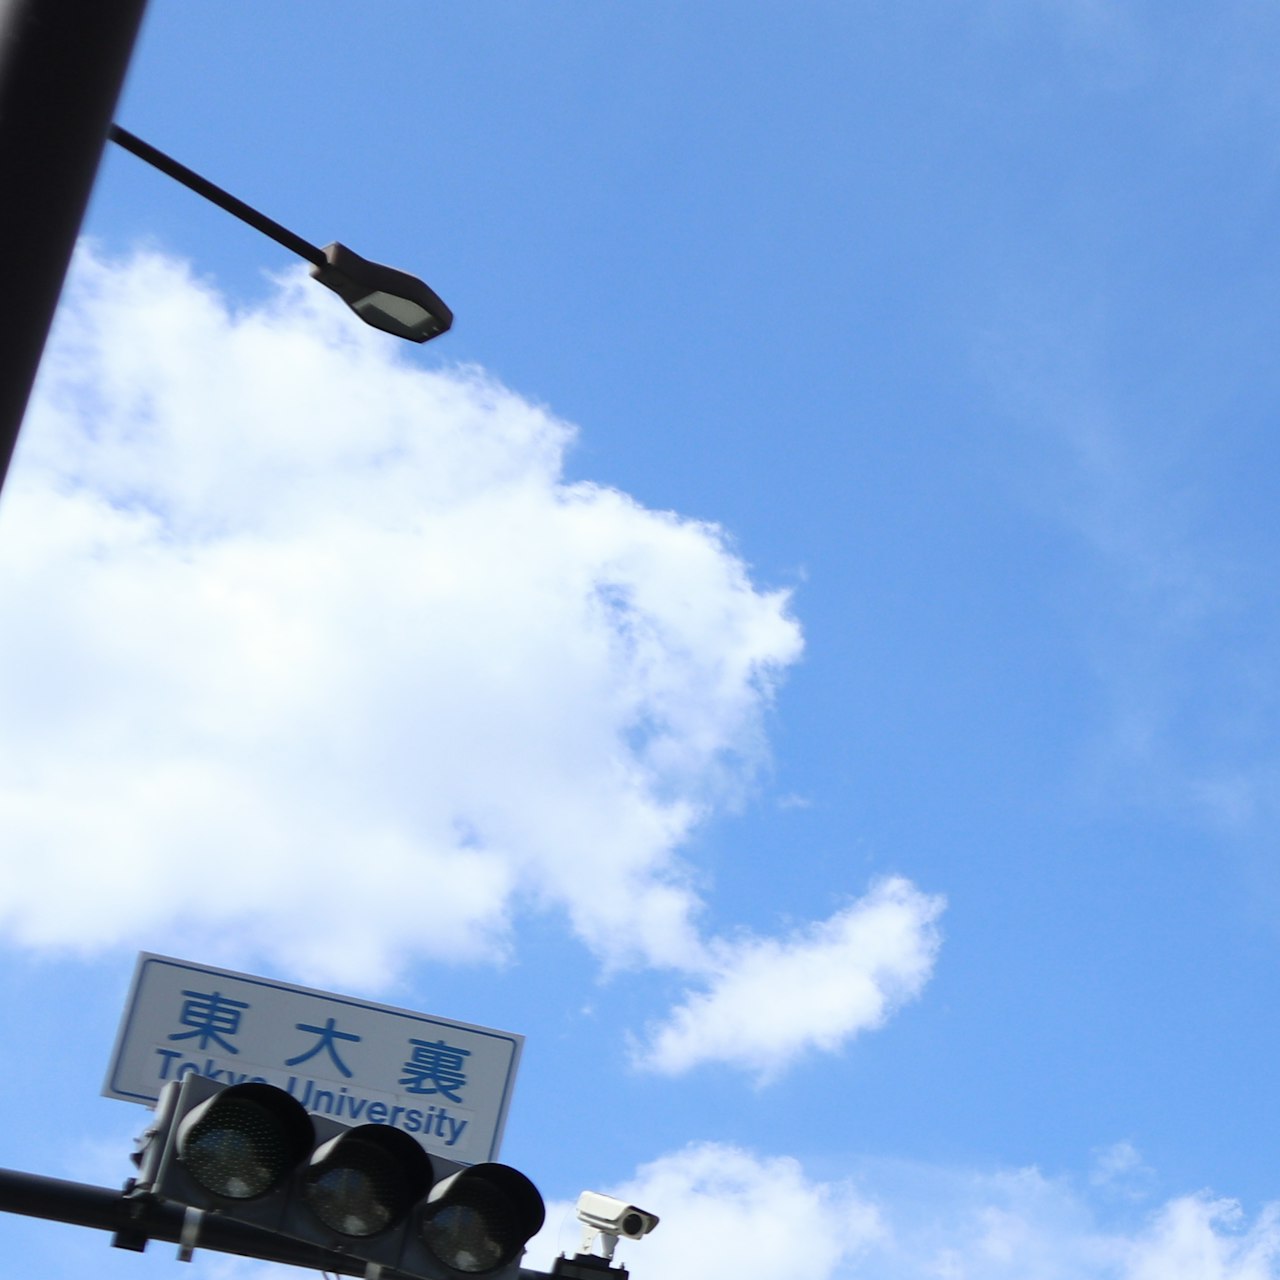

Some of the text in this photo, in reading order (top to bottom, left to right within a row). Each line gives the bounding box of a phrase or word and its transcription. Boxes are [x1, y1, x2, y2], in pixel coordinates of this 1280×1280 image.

[155, 1048, 468, 1146] Tok University
[167, 989, 471, 1104] 東大裏
